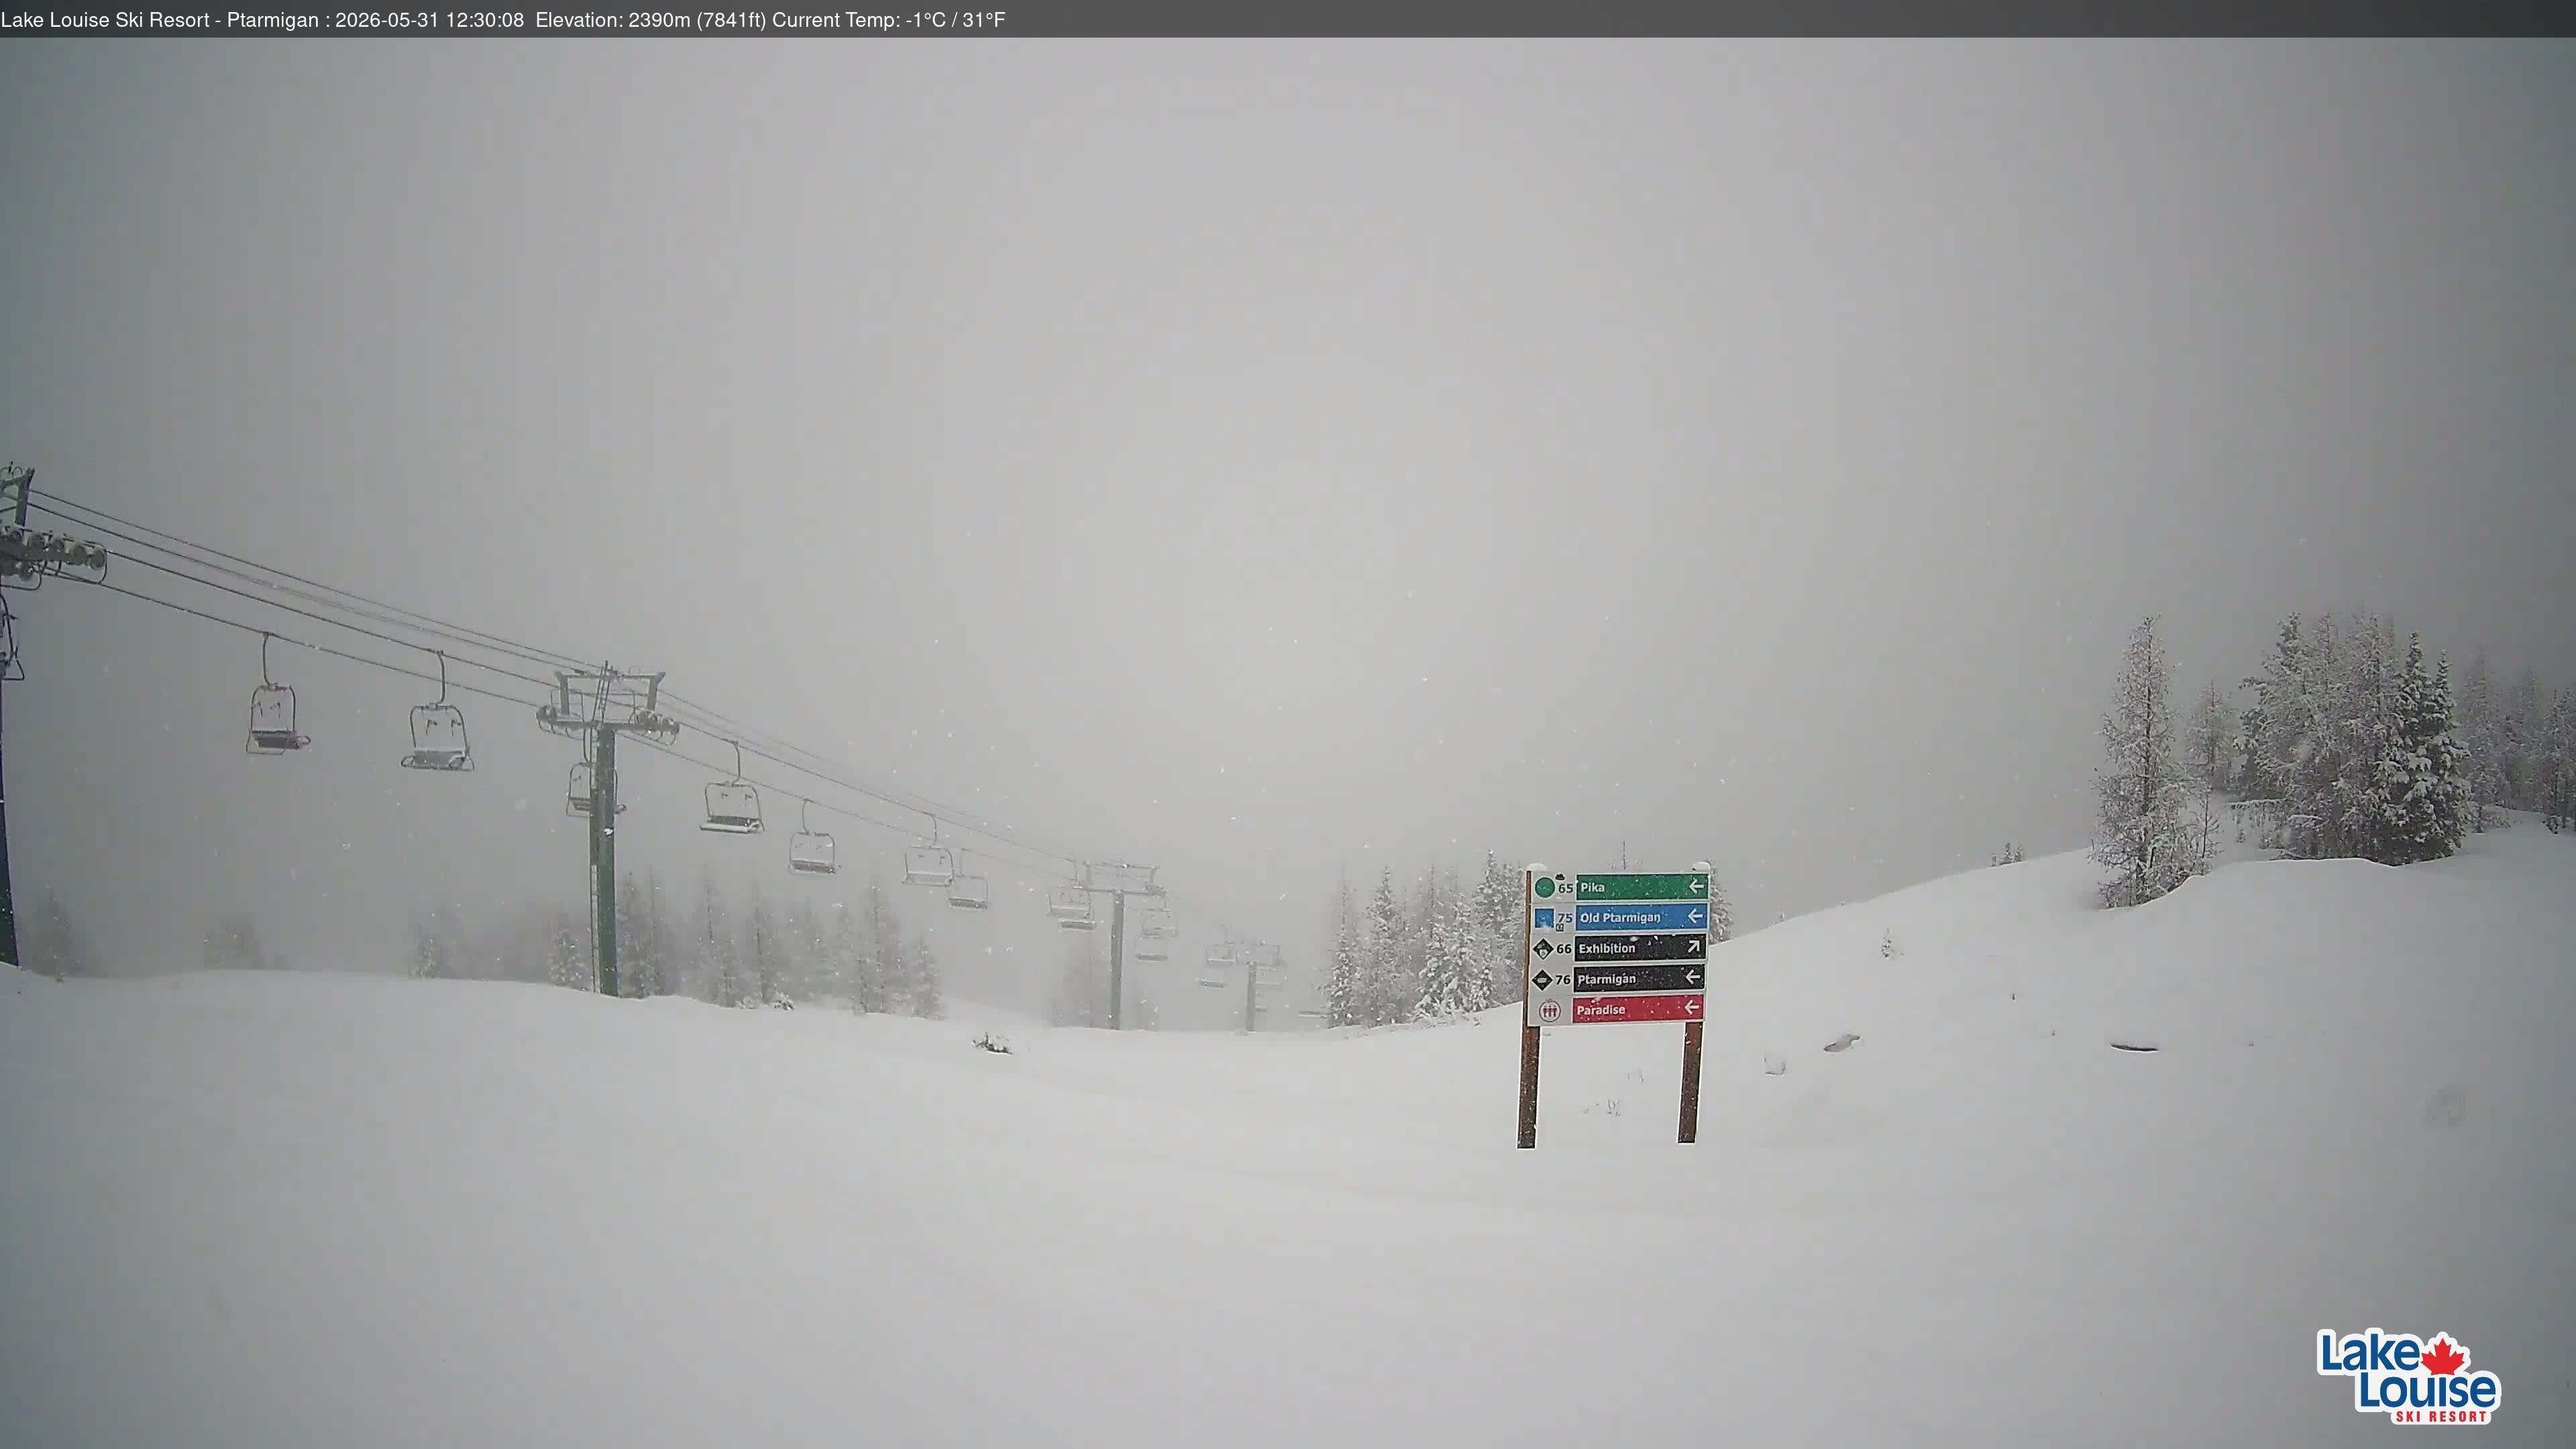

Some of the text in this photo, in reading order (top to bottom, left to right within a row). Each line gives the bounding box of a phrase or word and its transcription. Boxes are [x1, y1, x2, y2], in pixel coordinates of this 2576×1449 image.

[1558, 882, 1605, 894] 65 Pika
[1557, 913, 1661, 925] 75 Old Ptarmigan
[1556, 943, 1635, 954] 66 Exhibition
[1555, 975, 1636, 986] 76 Ptarmigan
[1576, 1005, 1625, 1015] Paradise
